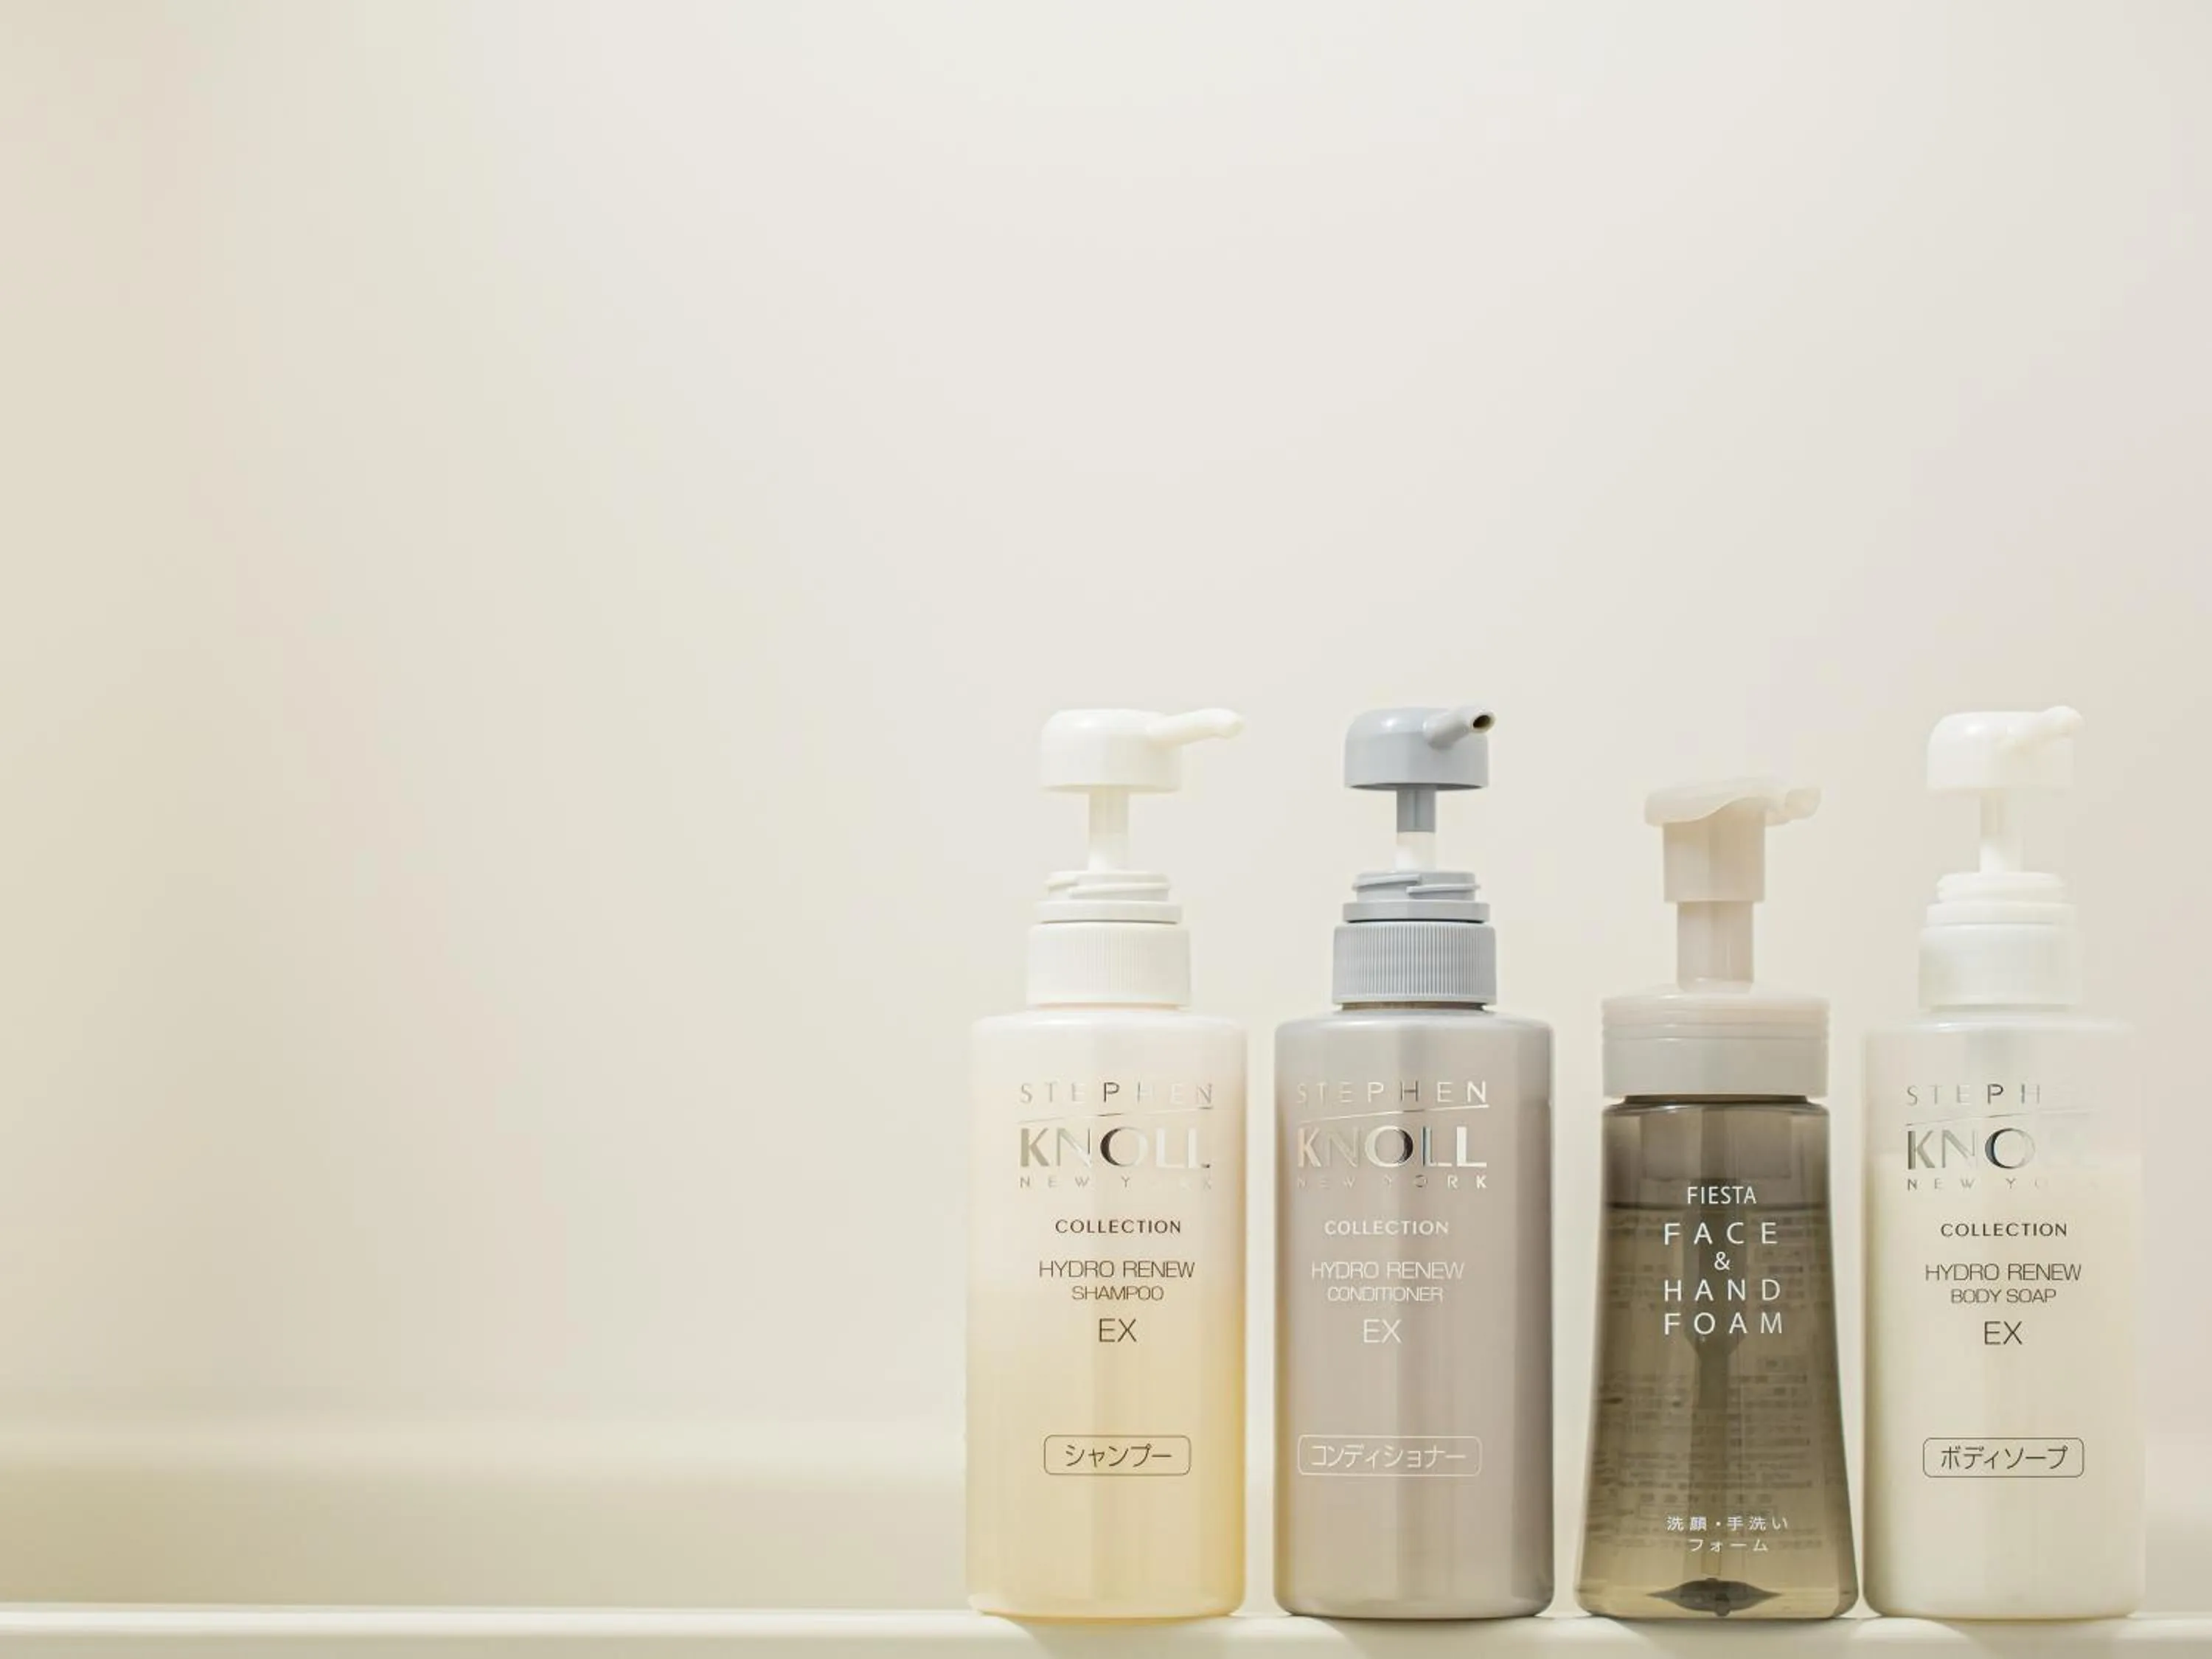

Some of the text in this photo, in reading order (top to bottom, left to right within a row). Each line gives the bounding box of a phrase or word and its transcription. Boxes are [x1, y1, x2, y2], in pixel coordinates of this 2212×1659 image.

[1019, 1081, 1214, 1105] STEPHEN
[1297, 1080, 1487, 1103] STEPHEN
[1906, 1083, 2041, 1106] STEPH
[1018, 1127, 1212, 1169] KNOLL
[1296, 1124, 1488, 1168] KNOLL
[1906, 1127, 2037, 1170] KNO
[1019, 1175, 1091, 1189] NEW
[1906, 1178, 1976, 1191] NEW
[1687, 1186, 1757, 1204] FIESTA
[1054, 1219, 1181, 1234] COLLECTION
[1324, 1220, 1450, 1236] COLLECTION
[1663, 1221, 1778, 1245] FACE
[1940, 1222, 2067, 1237] COLLECTION
[1038, 1259, 1195, 1279] HYDRO RENEW
[1311, 1261, 1465, 1279] HYDRO RENEW
[1714, 1251, 1731, 1270] &
[1924, 1263, 2081, 1281] HYDRO RENEW
[1071, 1285, 1164, 1301] SHAMPOO
[1326, 1287, 1443, 1302] CONDITIONER
[1663, 1279, 1781, 1301] HAND
[1951, 1288, 2057, 1304] BODY SOAP
[1099, 1318, 1137, 1343] EX
[1363, 1319, 1402, 1343] EX
[1663, 1312, 1783, 1335] FOAM
[1984, 1321, 2023, 1345] EX
[1065, 1443, 1172, 1468] シャンプー
[1311, 1444, 1467, 1469] コンディショナー
[1941, 1444, 2069, 1470] ボディソープ
[1666, 1515, 1789, 1531] 洗顔・手洗い
[1688, 1538, 1768, 1552] フォーム
